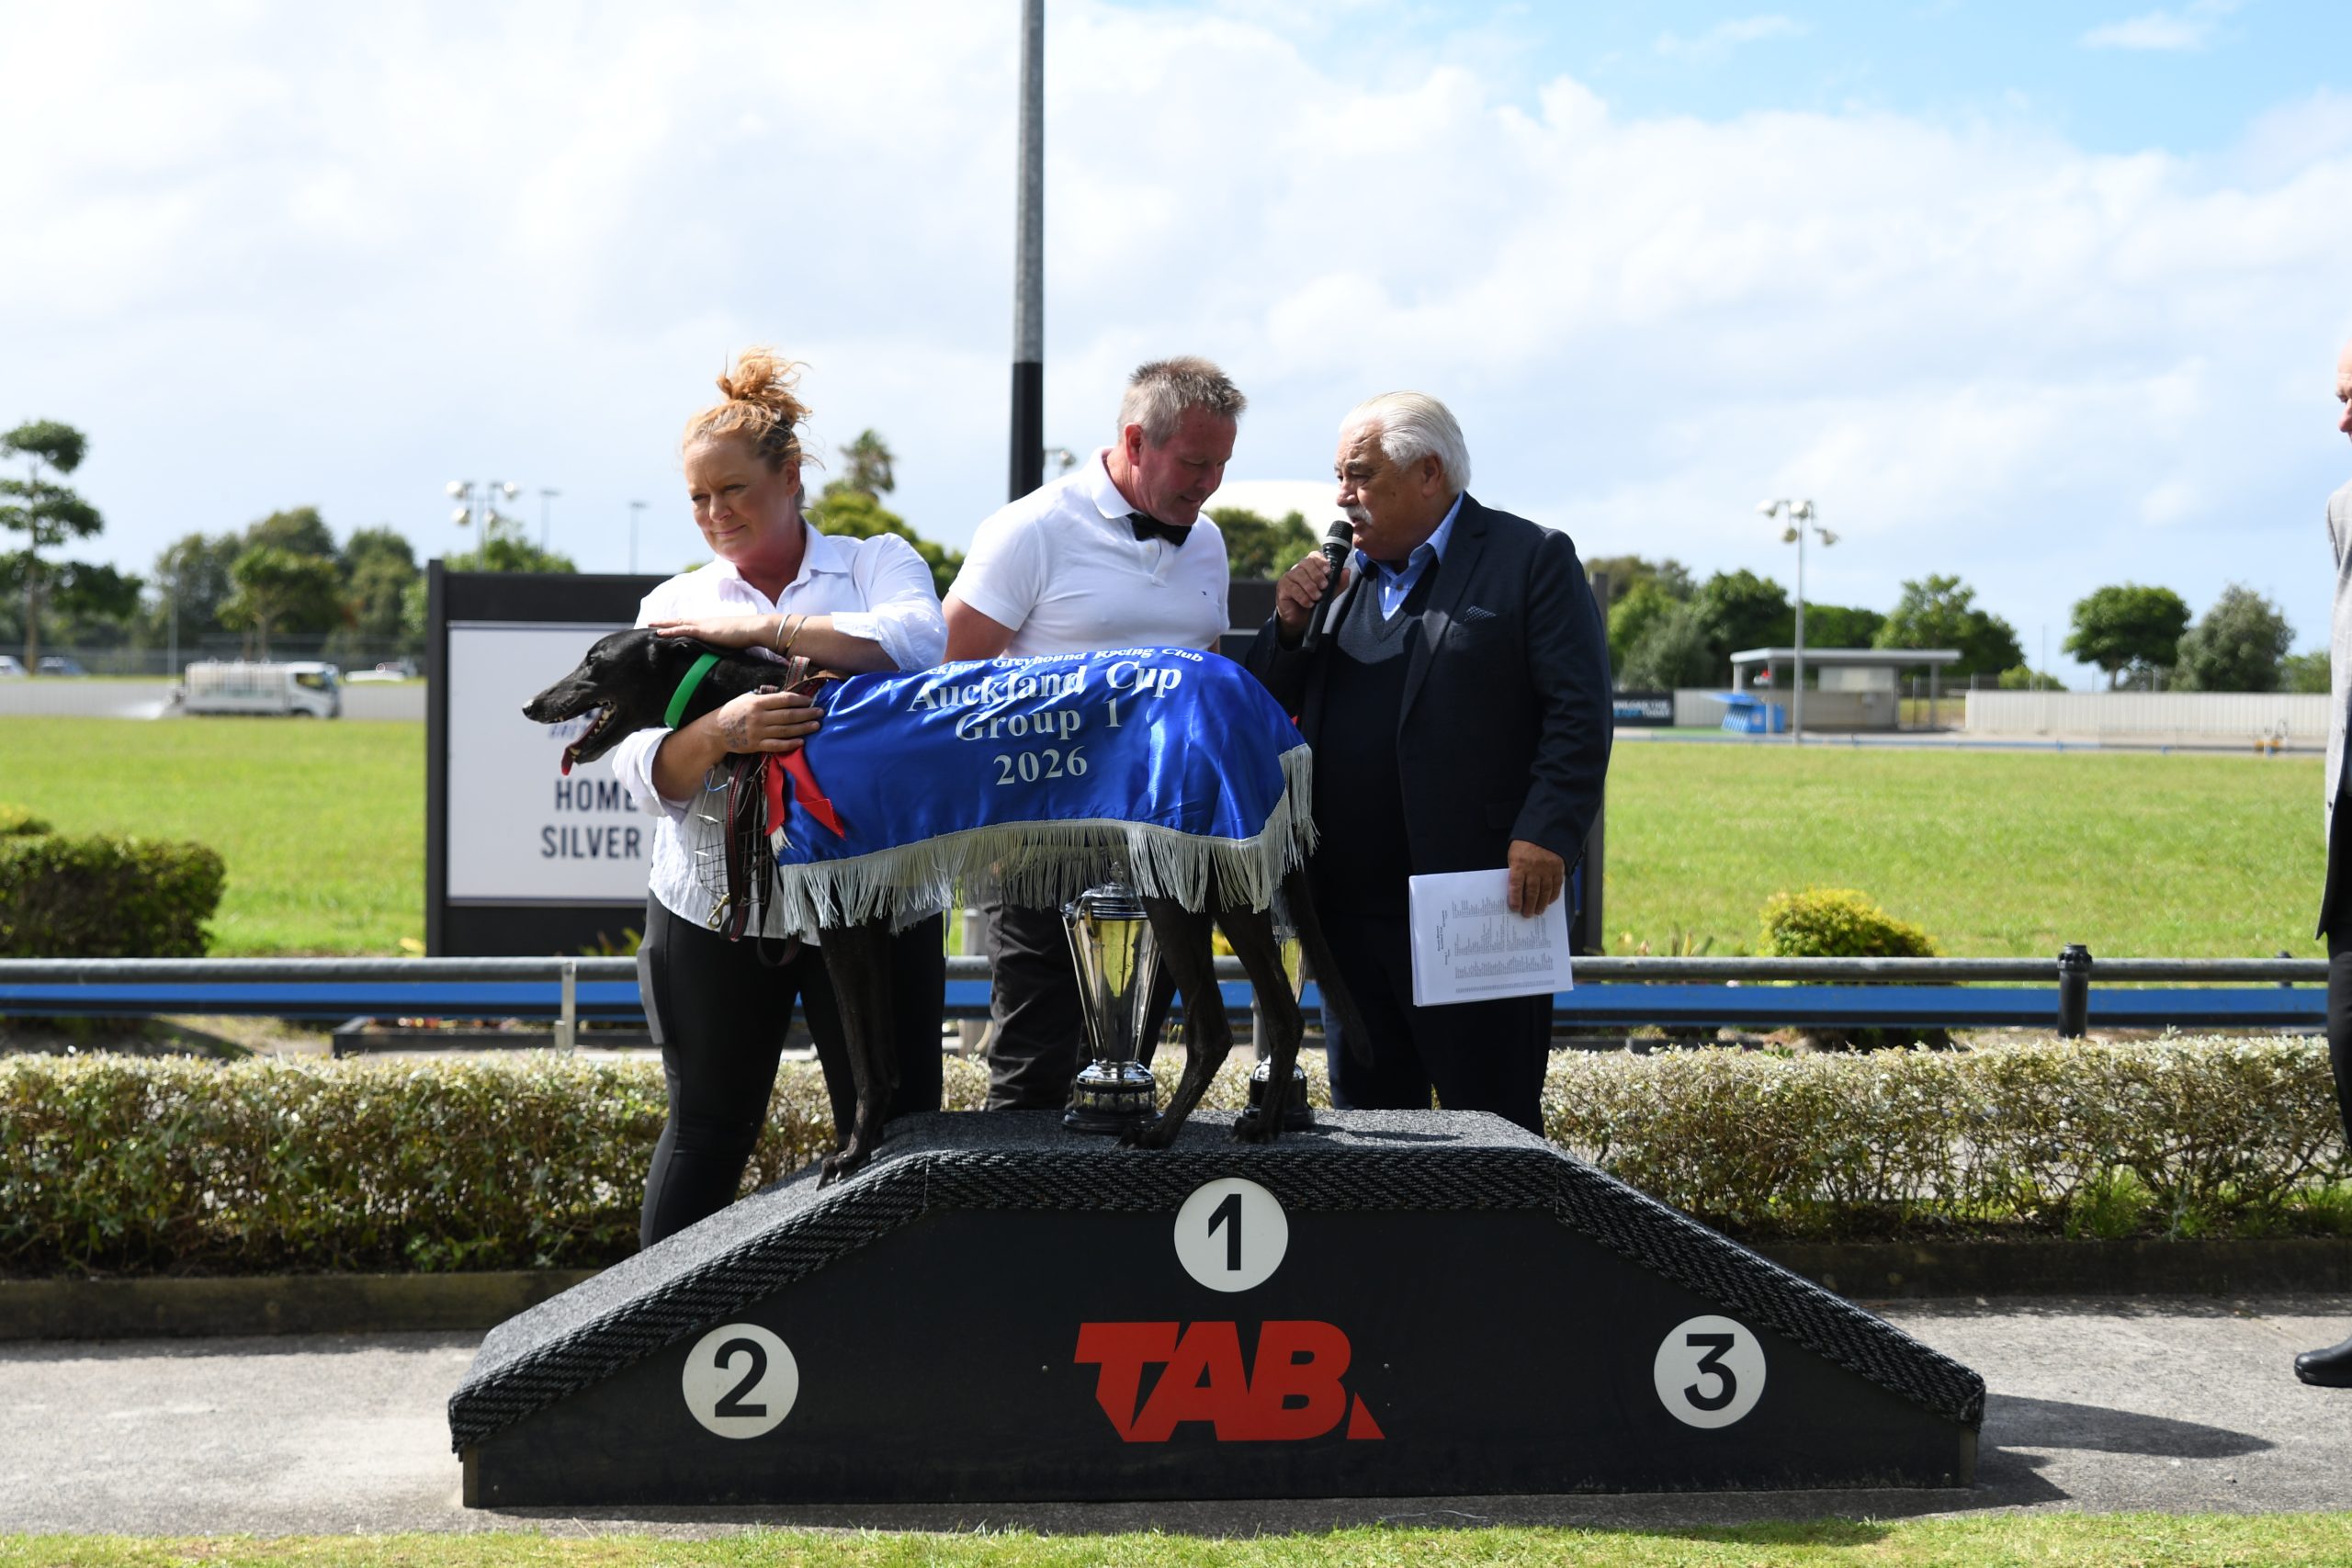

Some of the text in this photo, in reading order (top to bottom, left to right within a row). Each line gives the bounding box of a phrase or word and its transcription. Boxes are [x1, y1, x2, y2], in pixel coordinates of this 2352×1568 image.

[906, 660, 1182, 712] Auckland Cup
[926, 648, 1204, 676] ckland Greyhound Racing Club
[955, 697, 1123, 740] Group 1
[993, 745, 1088, 785] 2026
[541, 825, 641, 859] SILVER
[1207, 1193, 1242, 1270] 1
[714, 1337, 768, 1418] 2
[1073, 1320, 1351, 1442] TAB
[1683, 1333, 1737, 1412] 3
